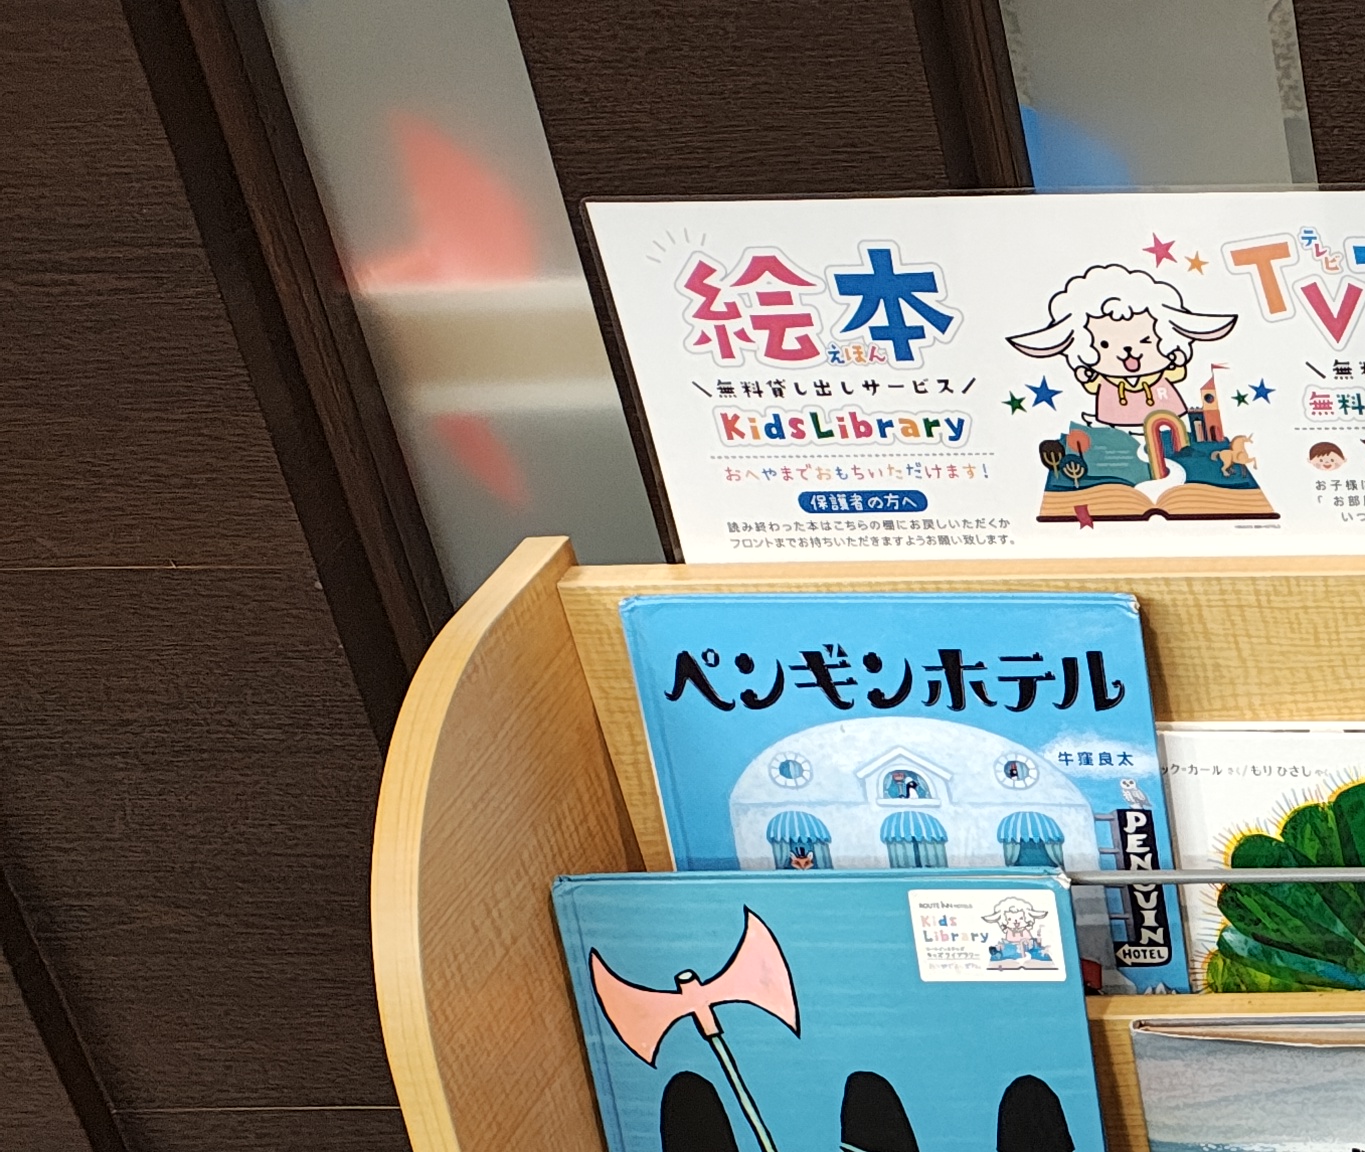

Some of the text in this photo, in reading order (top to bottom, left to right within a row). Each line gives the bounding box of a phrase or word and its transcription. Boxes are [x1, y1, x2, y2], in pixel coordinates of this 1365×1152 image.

[684, 248, 954, 363] 絵本
[826, 343, 886, 365] えほん
[811, 492, 917, 511] 保護者の方へ
[665, 643, 1125, 712] ペンギンホテル
[1058, 750, 1135, 768] 牛窪良太
[1123, 811, 1164, 945] PENUIN
[920, 915, 957, 927] Kids
[923, 930, 989, 943] Library
[1122, 948, 1165, 960] HOTEL
